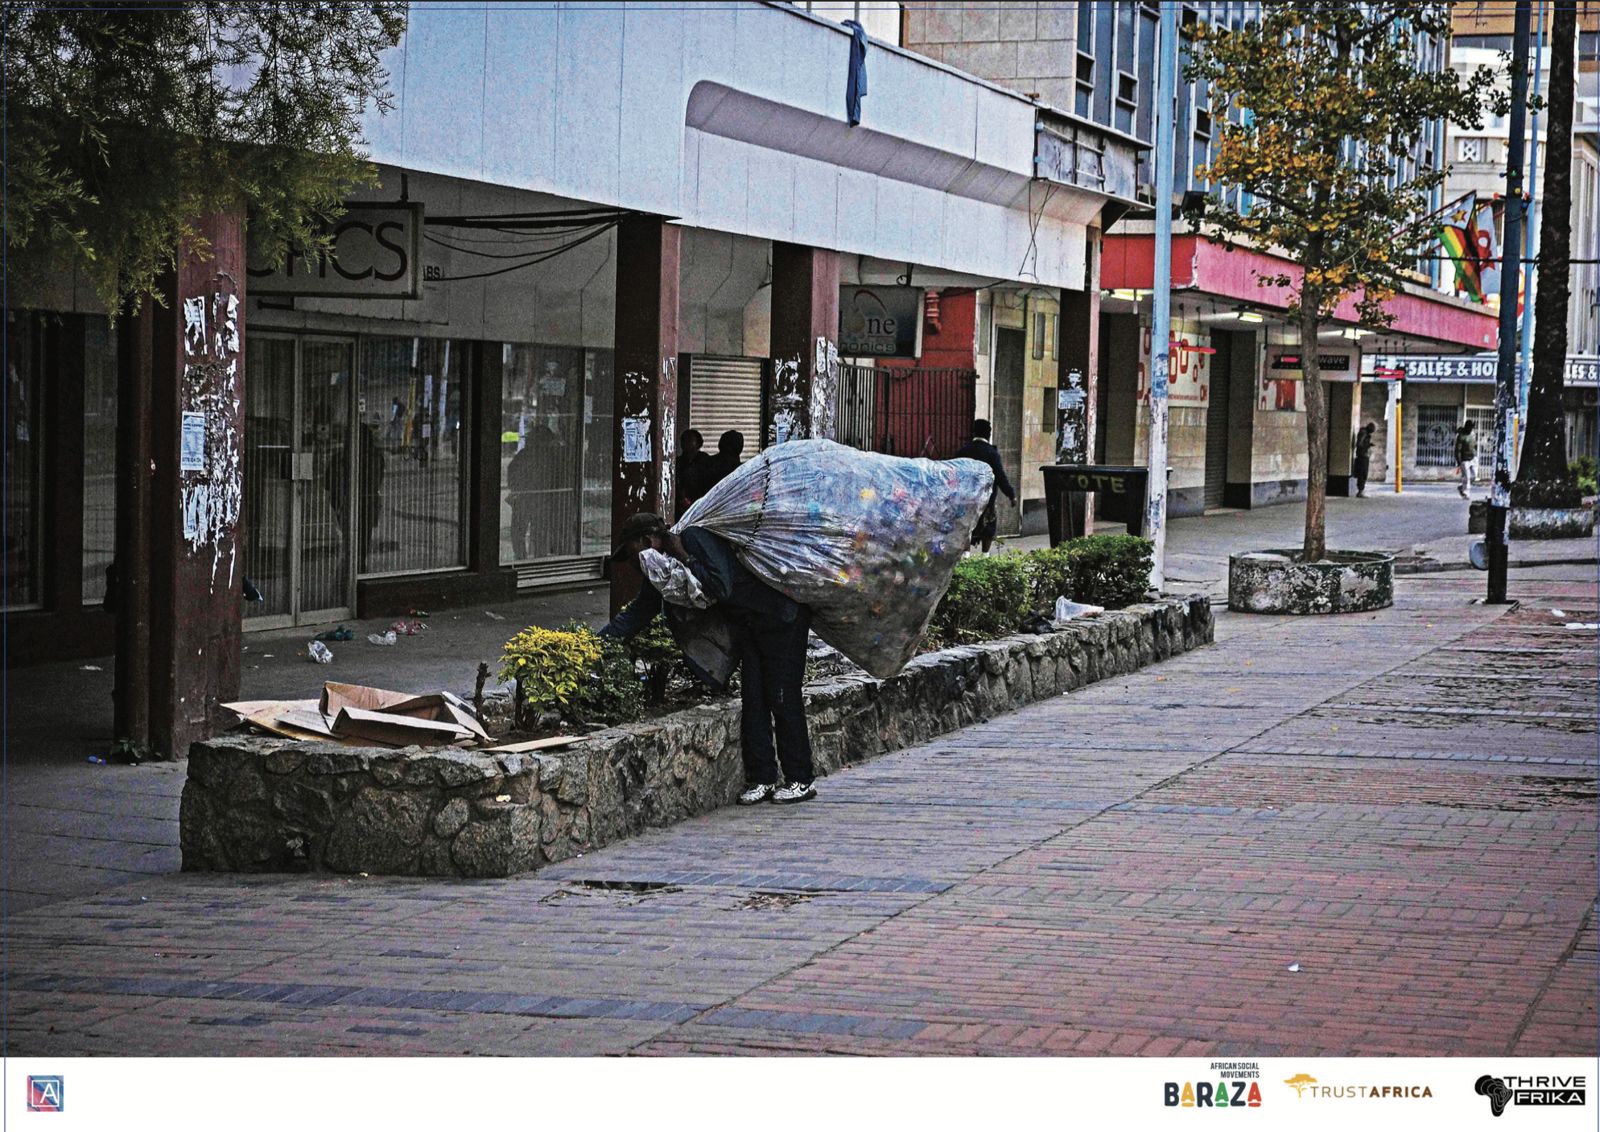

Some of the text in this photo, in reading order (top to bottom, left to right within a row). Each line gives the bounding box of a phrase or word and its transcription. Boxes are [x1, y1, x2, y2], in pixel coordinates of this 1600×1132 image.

[1408, 361, 1453, 376] SALES
[1457, 362, 1469, 376] &
[1563, 364, 1597, 379] LES &
